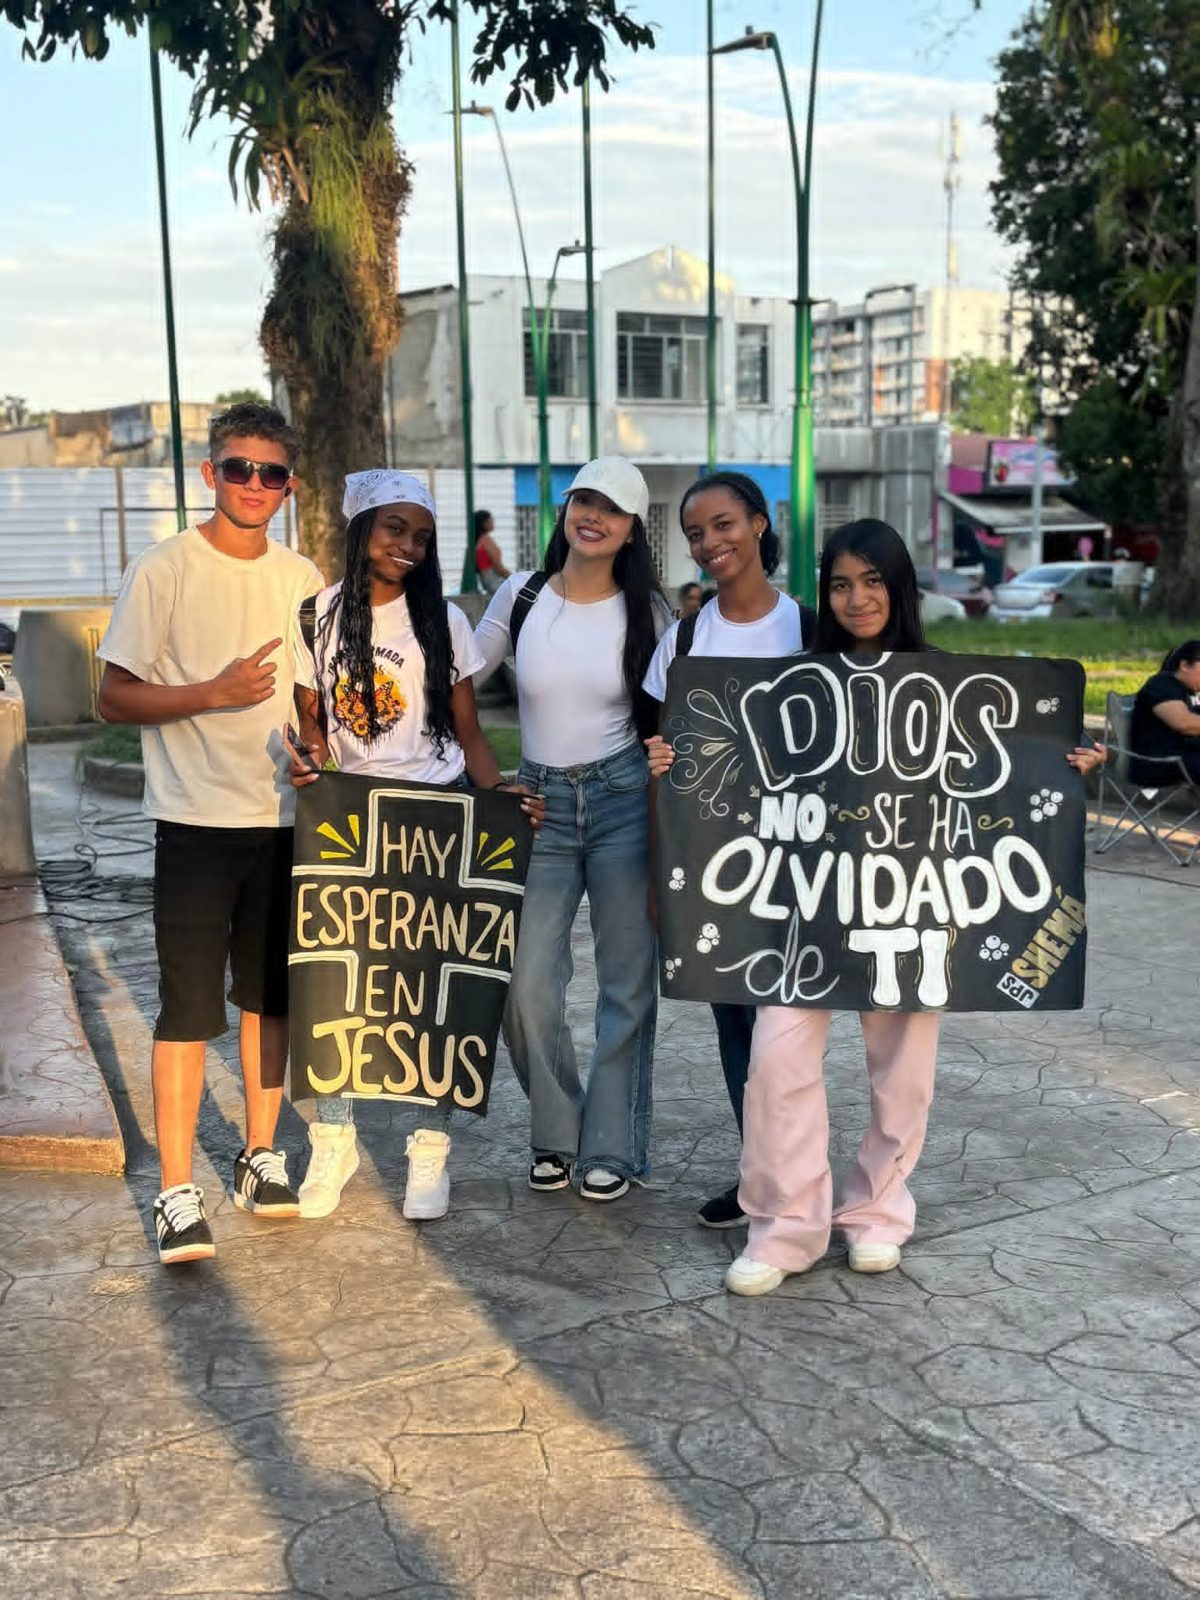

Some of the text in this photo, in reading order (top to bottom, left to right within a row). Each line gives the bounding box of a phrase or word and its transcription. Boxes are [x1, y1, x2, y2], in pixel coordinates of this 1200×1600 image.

[382, 821, 457, 878] HAY
[759, 792, 976, 852] NO SE HA
[701, 835, 1052, 928] OLVIDADO
[297, 883, 515, 968] ESPERANZA
[715, 906, 949, 1007] de TI
[365, 965, 425, 1017] EN
[1001, 975, 1034, 1002] JPS
[307, 1016, 487, 1107] JESUS
